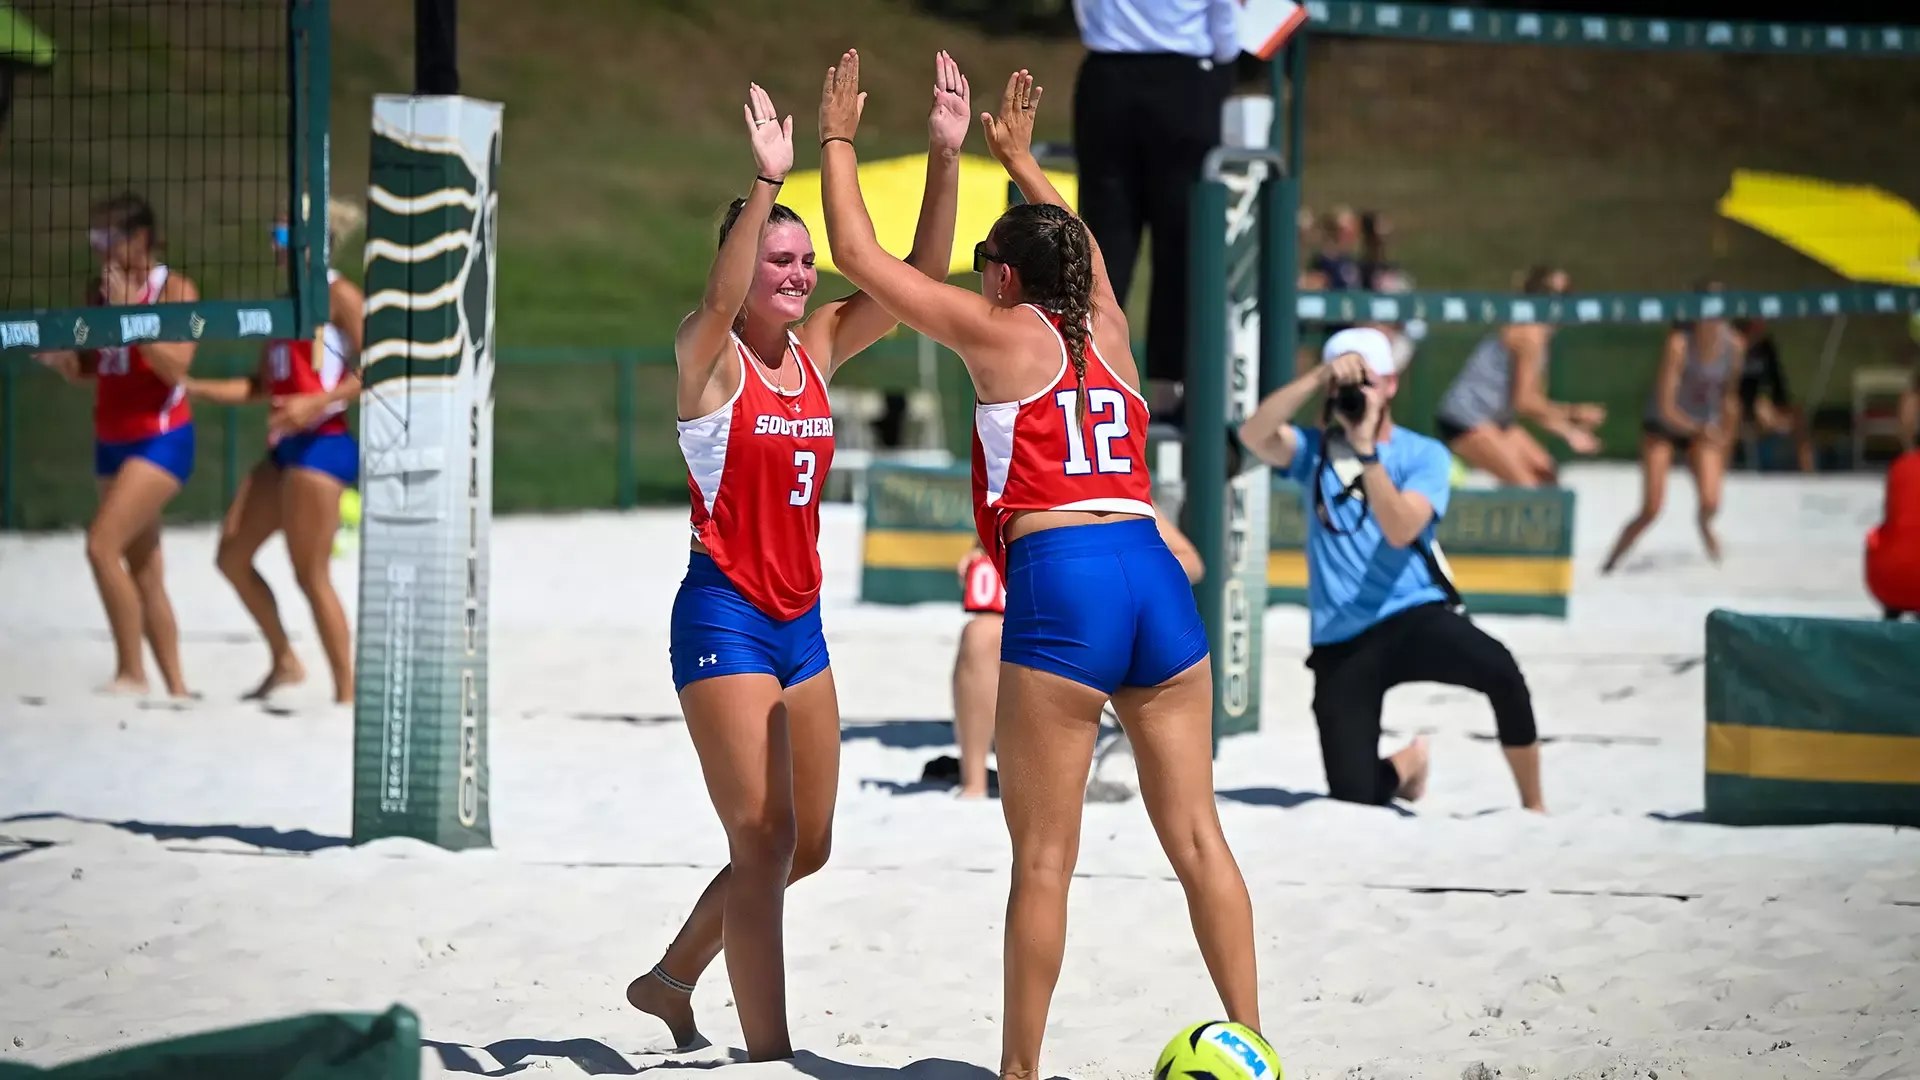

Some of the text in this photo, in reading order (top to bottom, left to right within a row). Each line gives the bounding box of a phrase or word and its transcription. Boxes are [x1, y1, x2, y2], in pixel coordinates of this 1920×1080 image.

[0, 320, 40, 349] LIONS
[1055, 388, 1132, 475] 12
[789, 450, 816, 507] 3
